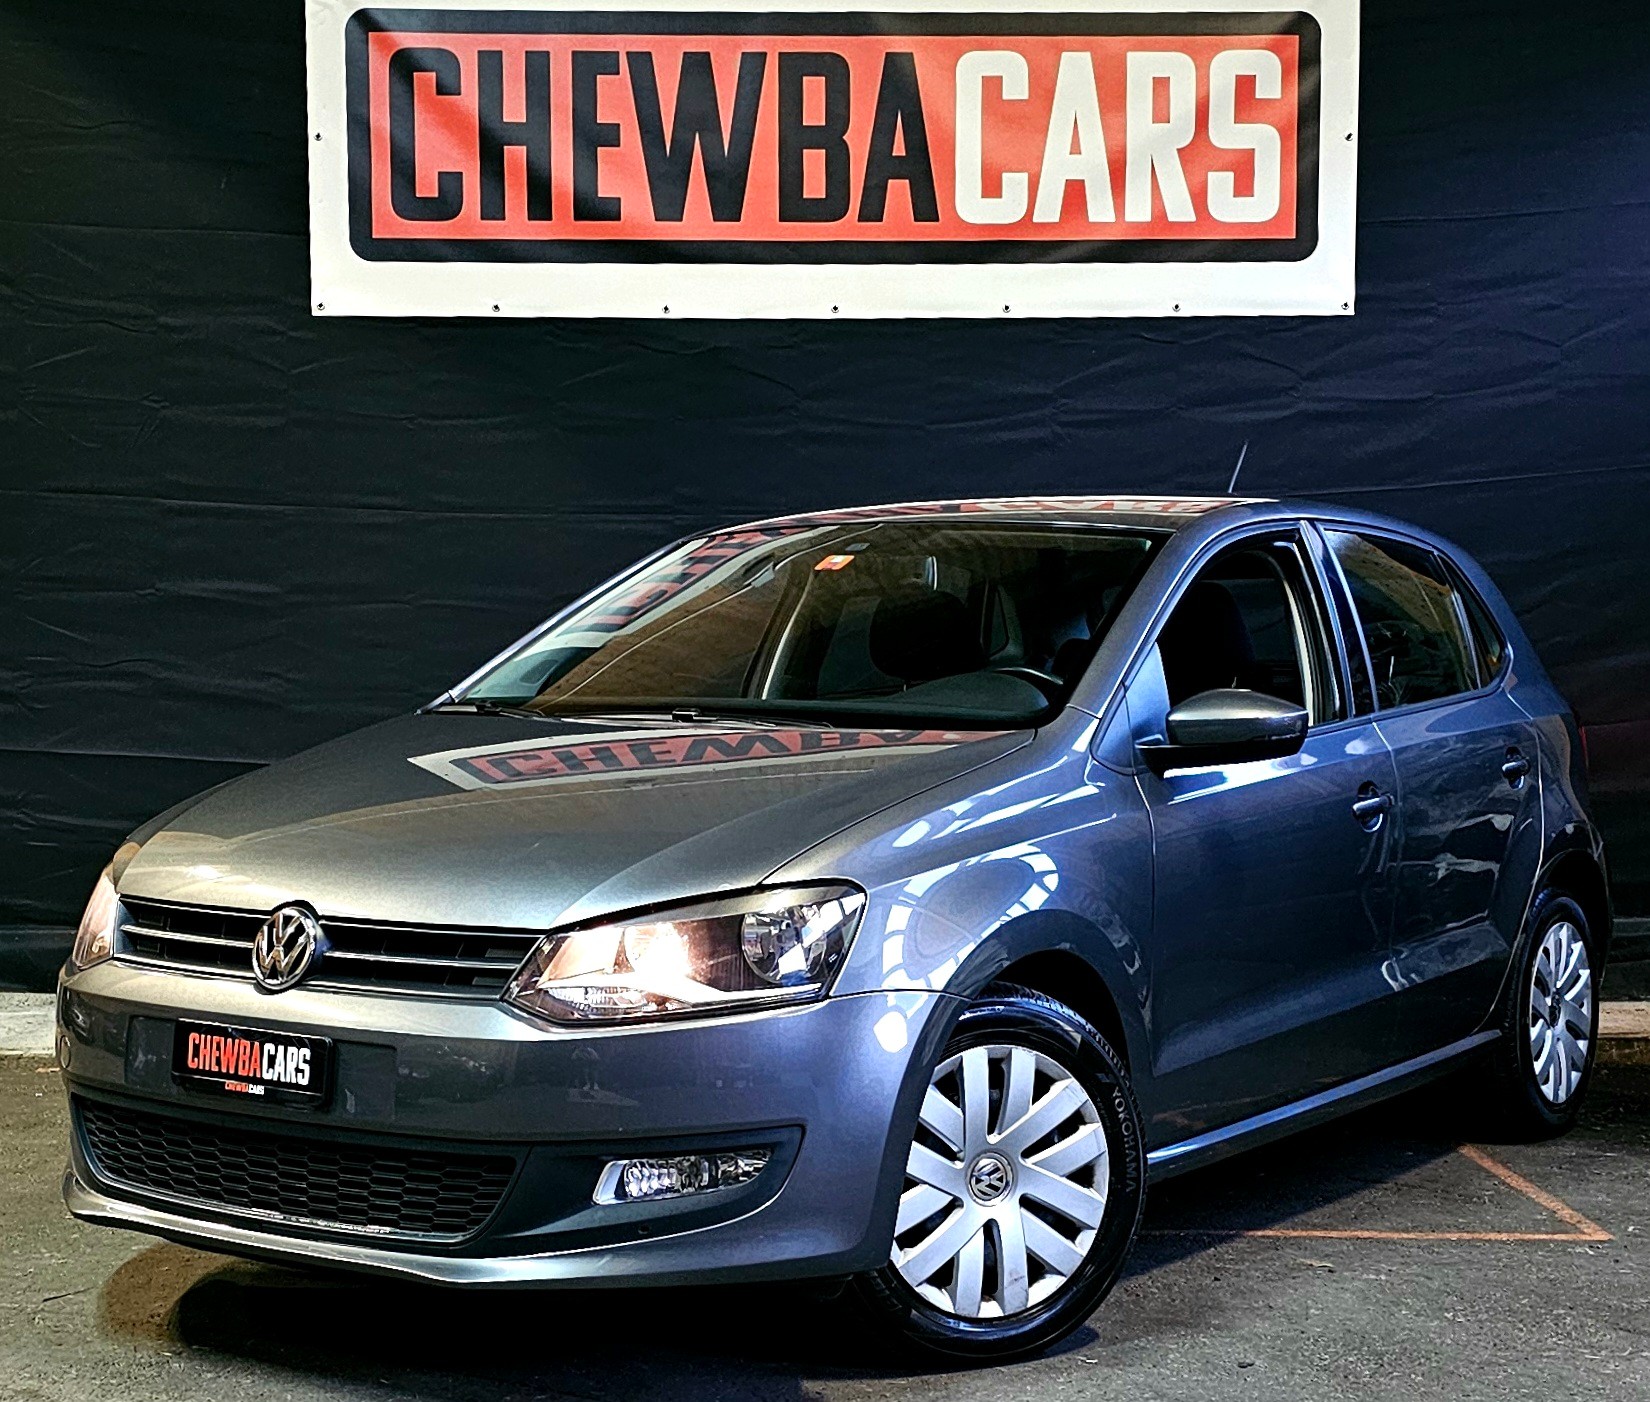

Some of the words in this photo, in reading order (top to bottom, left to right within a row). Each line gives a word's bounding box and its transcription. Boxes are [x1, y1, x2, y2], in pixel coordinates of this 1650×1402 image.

[388, 48, 1281, 225] CHEWBACARS
[187, 1032, 311, 1086] CHEWBACARS
[1112, 1085, 1137, 1193] YOKOHAMA
